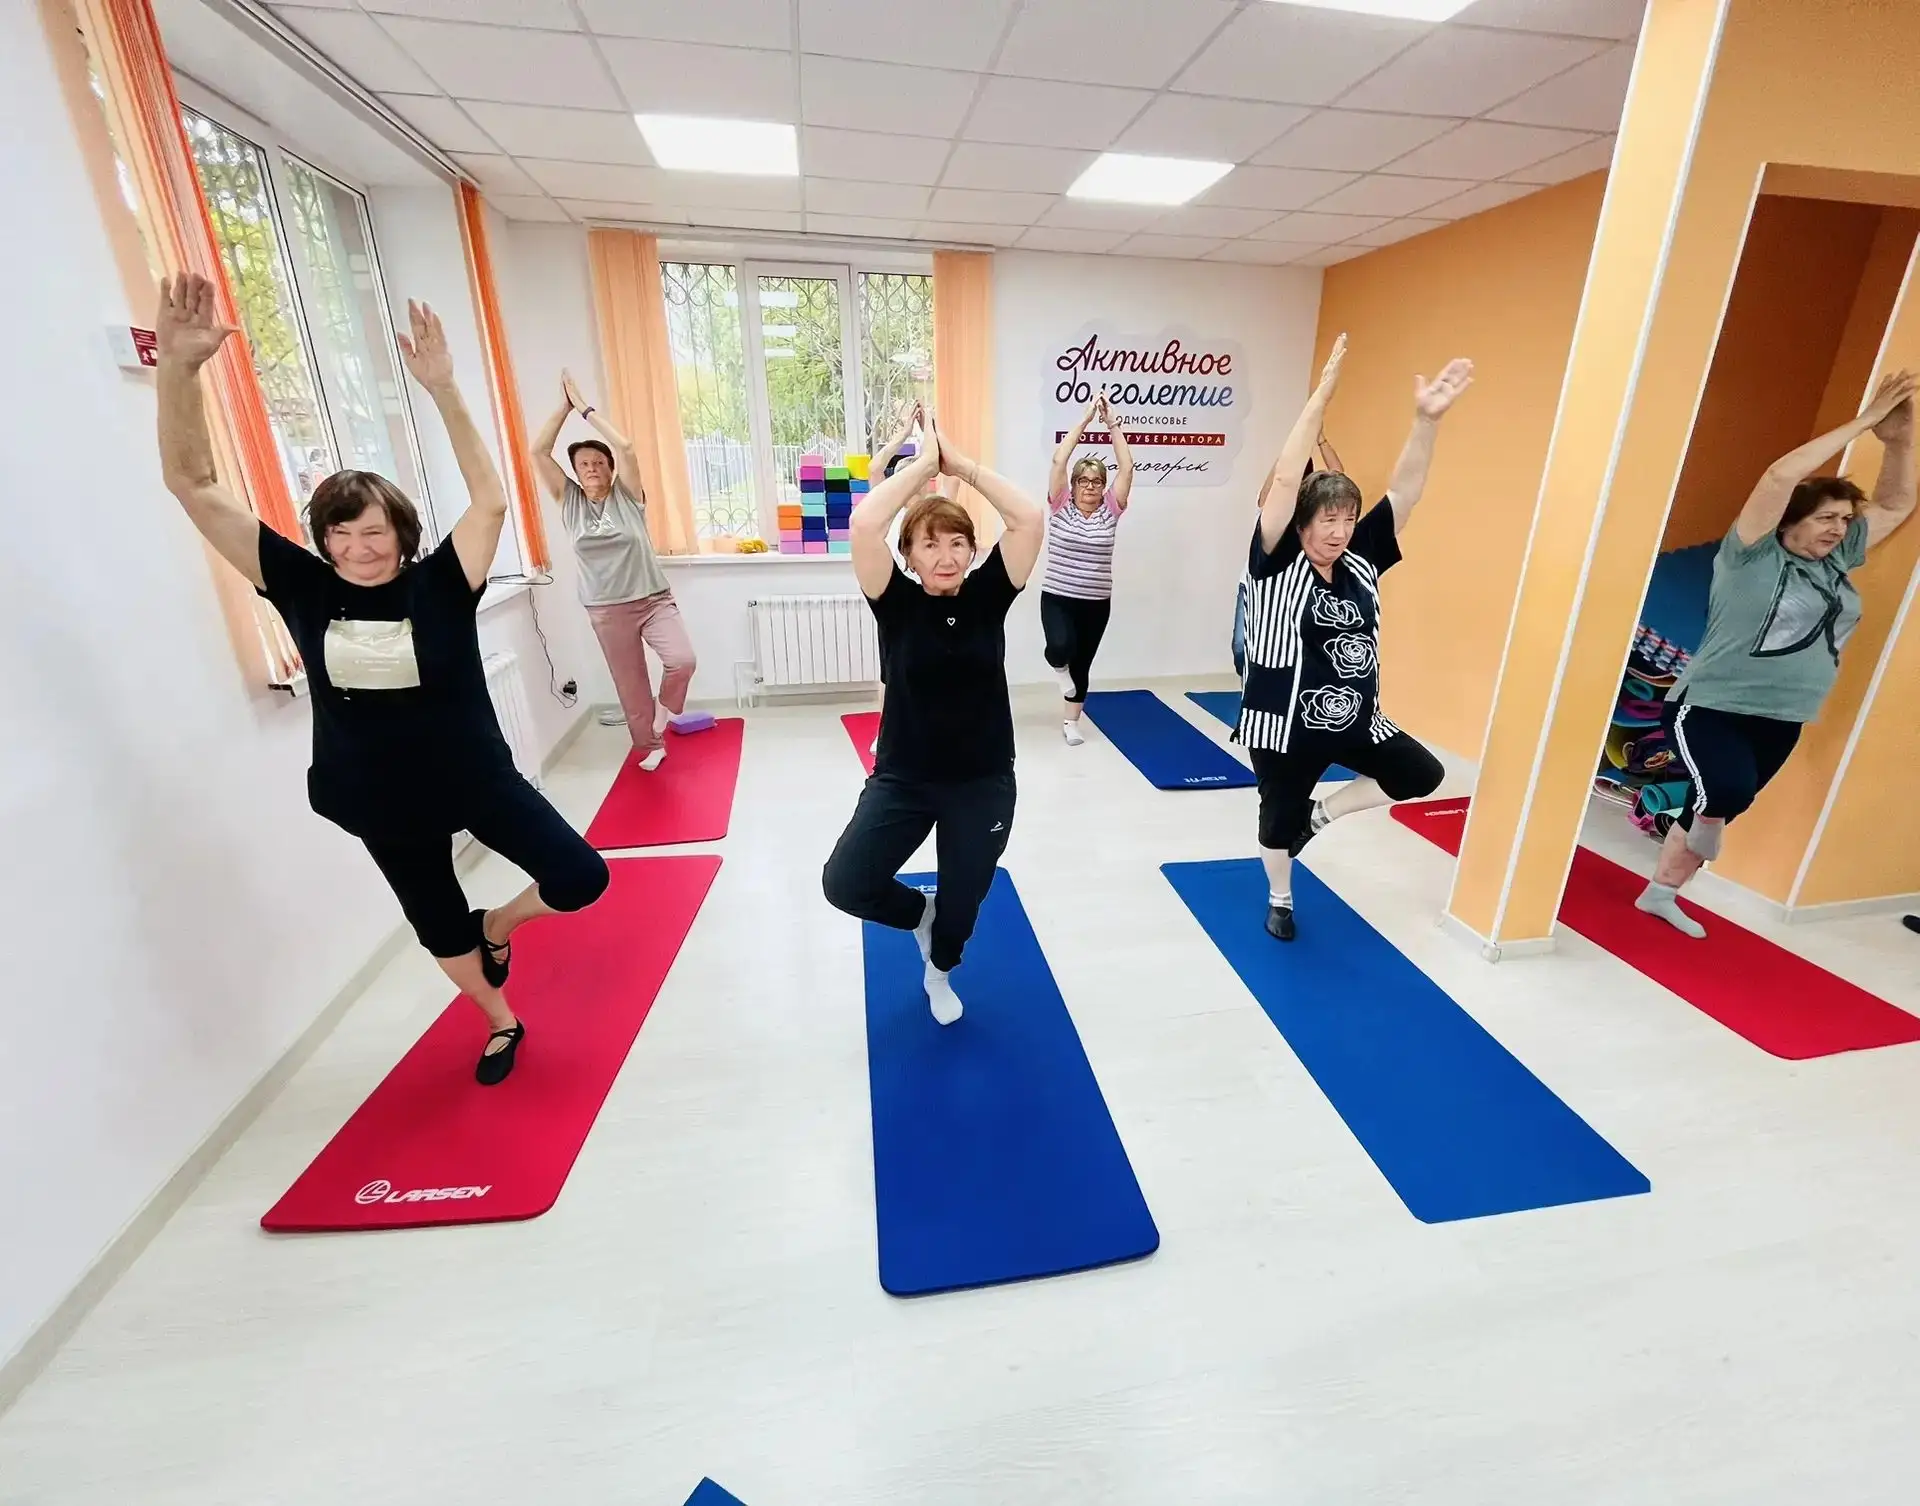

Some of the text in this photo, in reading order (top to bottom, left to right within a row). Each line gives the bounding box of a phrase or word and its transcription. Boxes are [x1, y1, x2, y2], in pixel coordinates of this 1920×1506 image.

[1056, 334, 1232, 375] Активное
[1056, 367, 1233, 407] доголетие
[1114, 415, 1187, 425] ОДМОСКОВЬЕ
[1127, 433, 1222, 444] ГУБЕРНАТОРА
[384, 1185, 492, 1203] LARSEN
